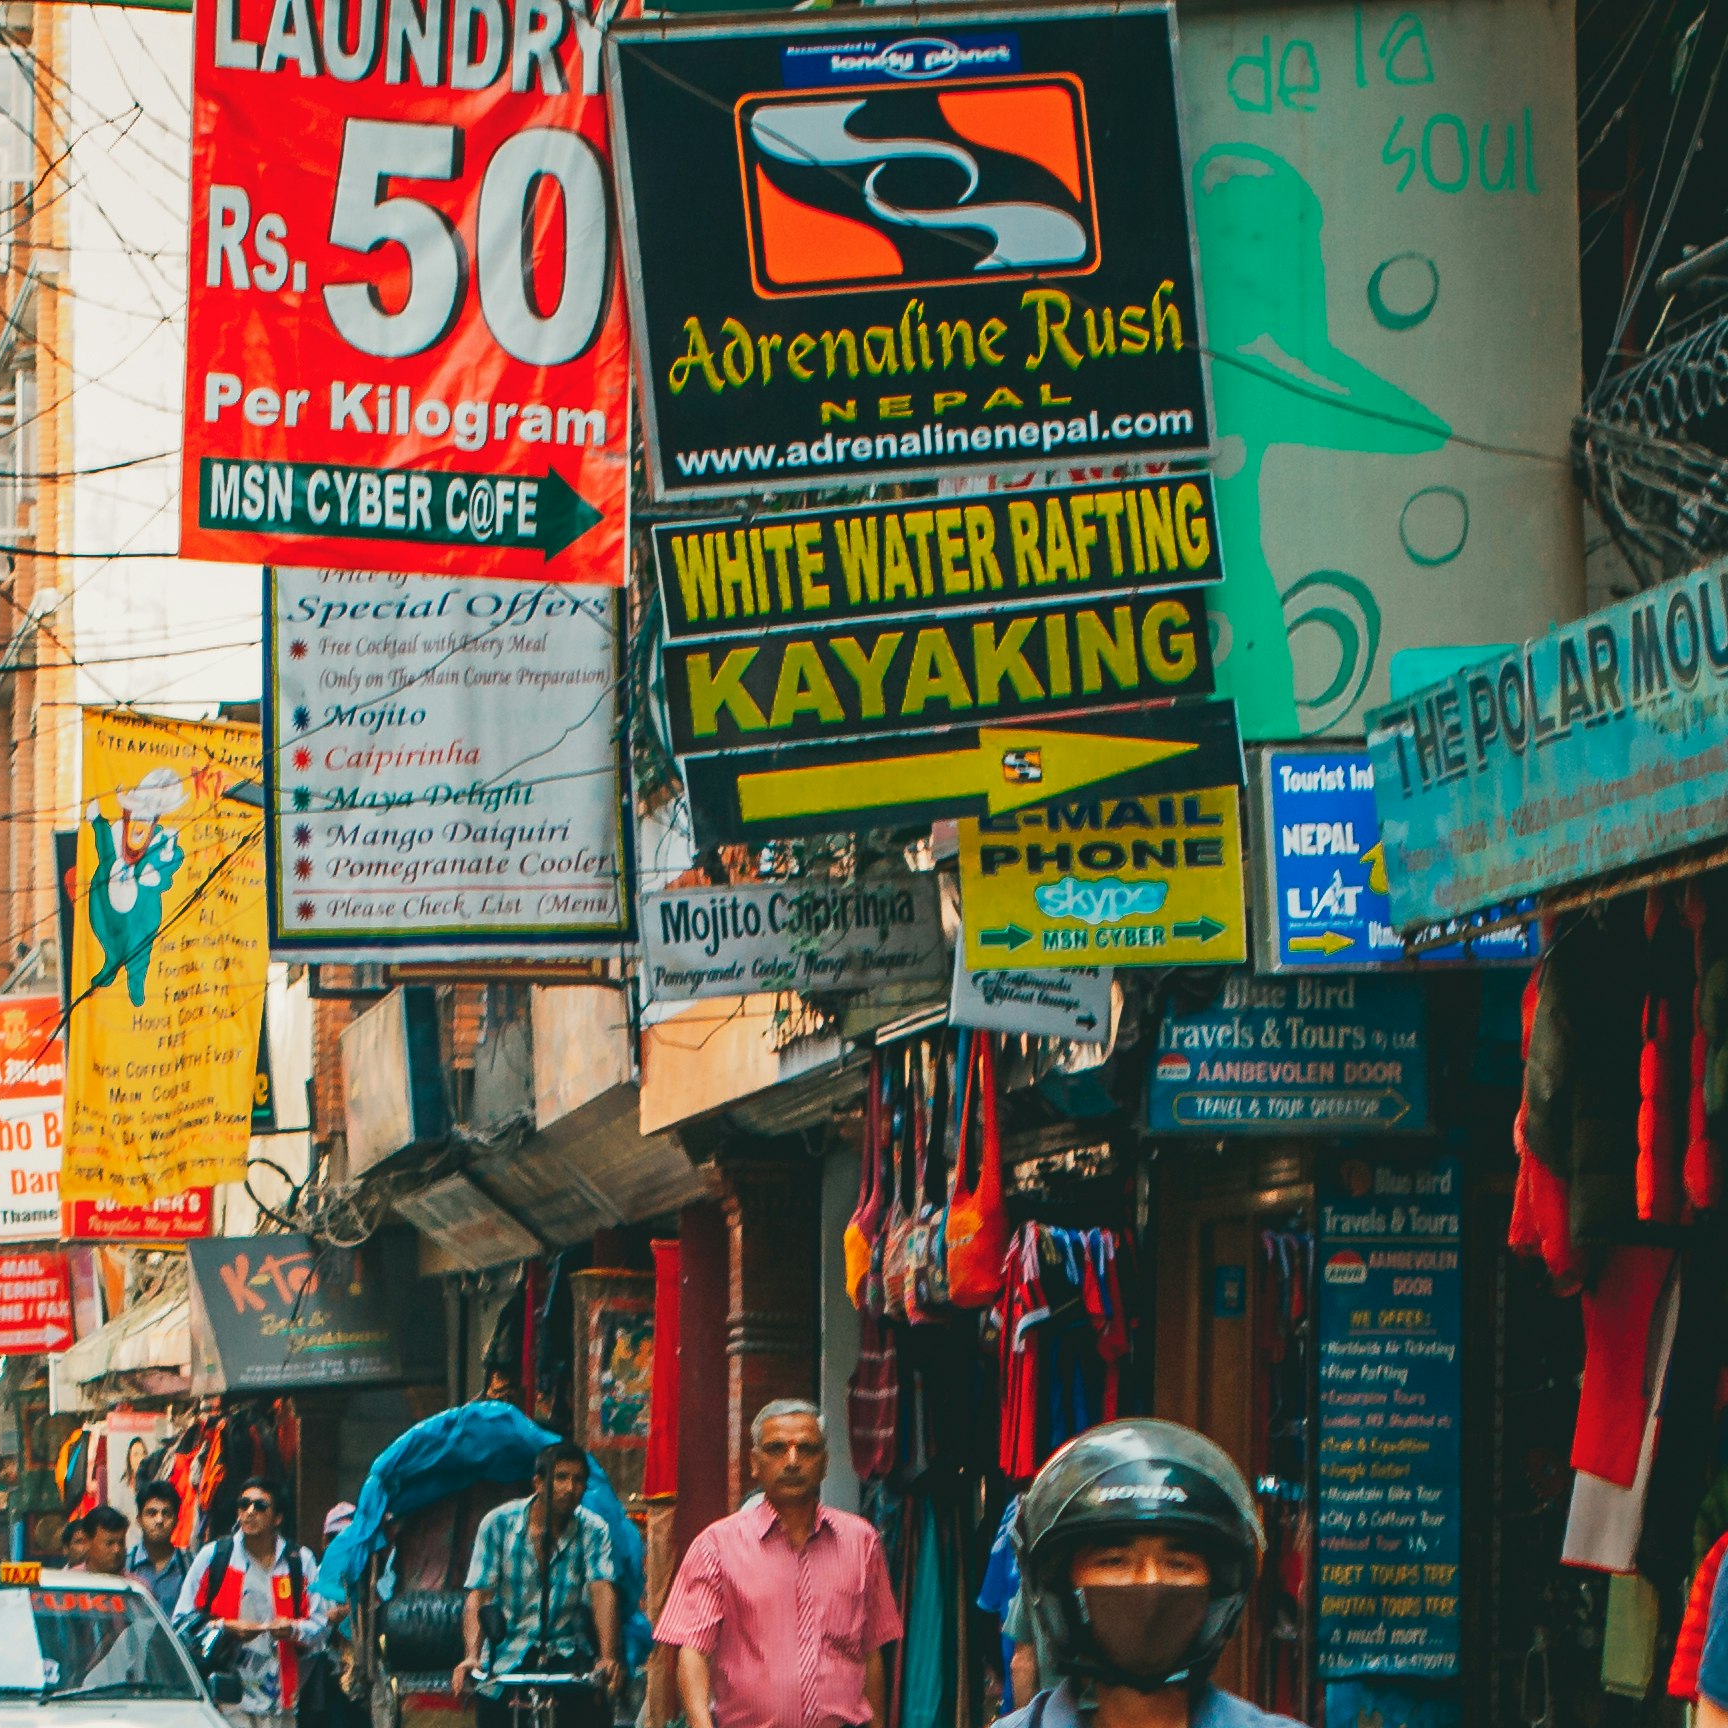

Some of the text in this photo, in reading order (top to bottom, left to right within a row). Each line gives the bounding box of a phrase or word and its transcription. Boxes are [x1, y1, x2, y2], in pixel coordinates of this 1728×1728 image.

[213, 0, 609, 95] LAUNDRY
[830, 44, 1011, 73] lonely planet
[1353, 6, 1436, 88] la
[1225, 36, 1321, 116] de
[206, 116, 615, 368] Rs. 50
[668, 279, 1185, 398] Adrenaline Rush
[204, 372, 607, 450] Per Kilogram
[818, 382, 1074, 426] NEPAL
[676, 405, 1194, 479] www.adrenalinenepal.com
[210, 462, 539, 541] MSN CYBER C@FE
[670, 480, 1212, 623] WHITE WATER RAFTING
[287, 587, 607, 629] Special Offers
[365, 674, 383, 688] on
[685, 597, 1201, 740] KAYAKING
[324, 703, 429, 735] Mojito
[1377, 689, 1470, 800] THE
[1469, 619, 1628, 778] POLAR
[323, 738, 481, 779] Caipirinha
[1279, 763, 1346, 793] Tourist
[324, 777, 536, 817] Maya Delight
[325, 814, 574, 855] Mango Daiquiri
[1281, 821, 1361, 858] NEPAL
[325, 846, 609, 887] Pomegranate Cooler
[978, 837, 1226, 878] PHONE
[325, 893, 397, 922] Please
[403, 891, 471, 920] Check
[536, 893, 620, 920] (Menu)
[1094, 926, 1167, 949] CYBER
[1295, 976, 1356, 1010] Bird
[1158, 1014, 1367, 1051] Travels & Tours
[1343, 1061, 1403, 1084] DOOR
[1323, 1205, 1387, 1234] Travels
[1408, 1204, 1460, 1234] Tours
[37, 1300, 69, 1320] FAX
[1, 1566, 41, 1585] TAXI
